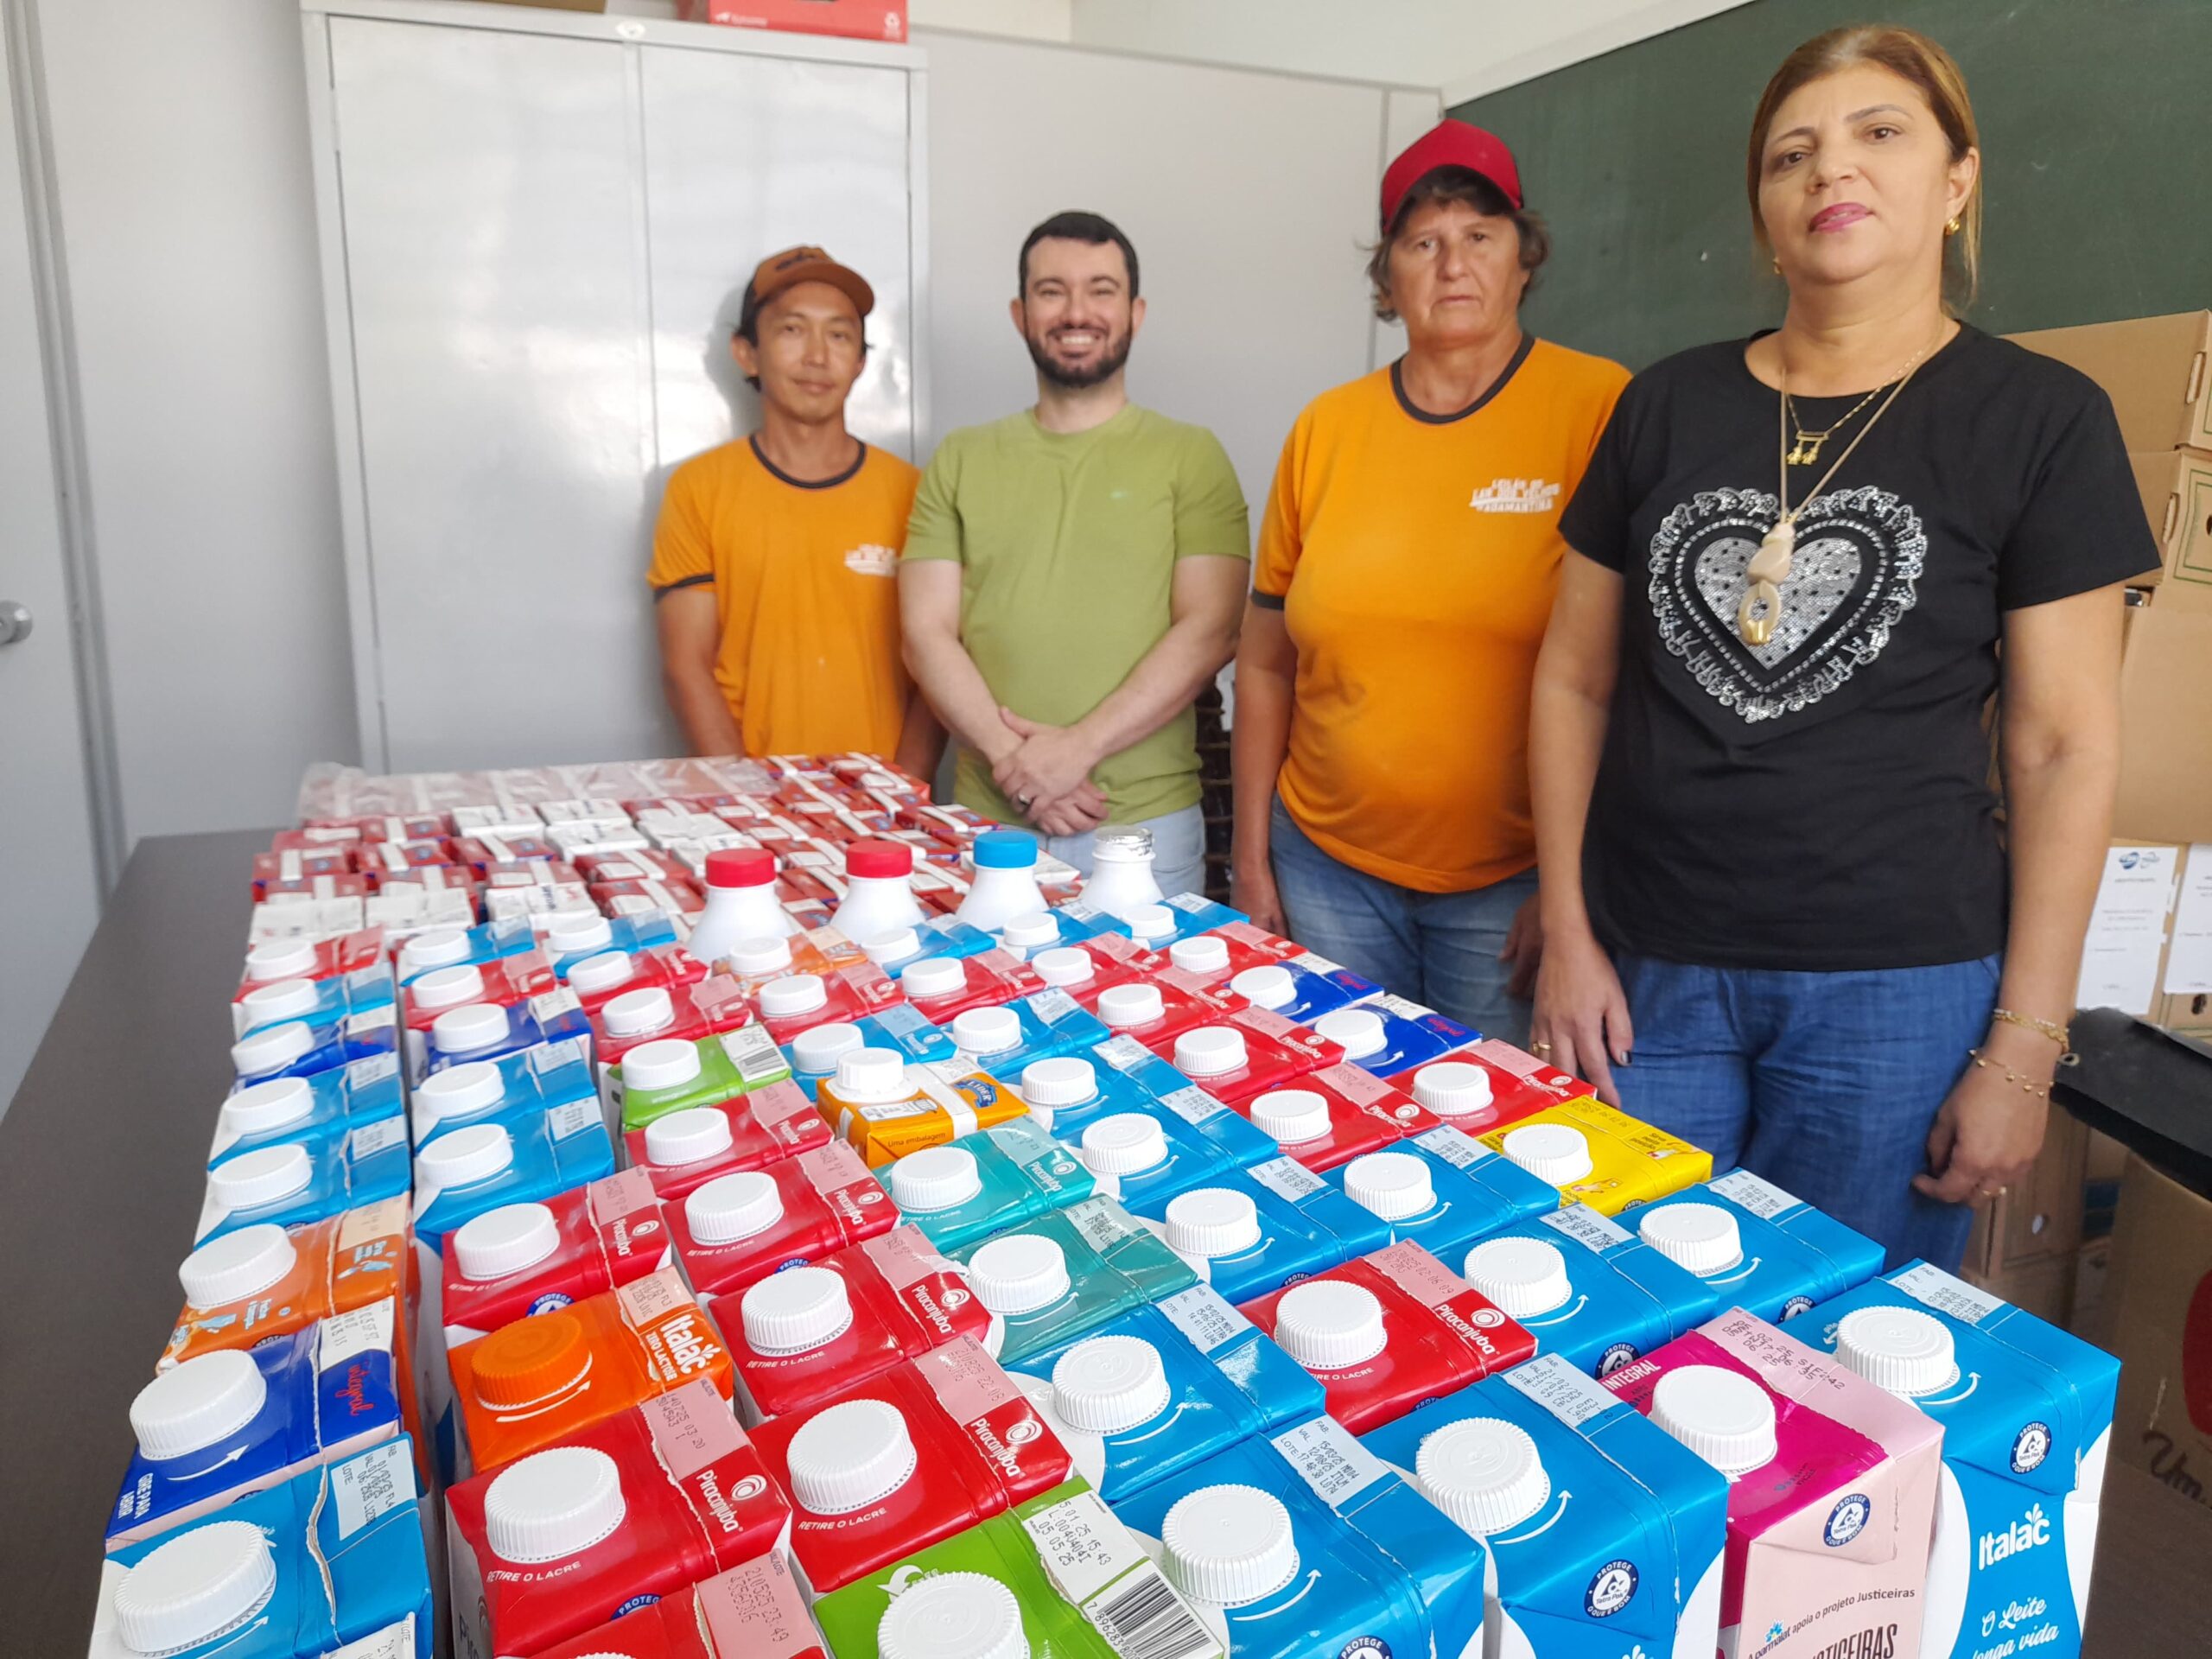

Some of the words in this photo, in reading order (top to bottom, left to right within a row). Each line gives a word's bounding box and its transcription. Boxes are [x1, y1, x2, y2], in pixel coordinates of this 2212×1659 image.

[912, 1284, 952, 1335] Piracanjuba
[1433, 1301, 1497, 1357] Piracanjuba
[658, 1312, 715, 1376] Italac
[1605, 1344, 1635, 1357] PROTEGE
[746, 1360, 777, 1370] RETIRE
[780, 1357, 788, 1367] O
[790, 1351, 824, 1365] LACRE
[1332, 1373, 1340, 1382] O
[1342, 1367, 1375, 1381] LACRE
[1601, 1359, 1662, 1391] INTEGRAL
[1298, 1428, 1312, 1443] VAL:
[1314, 1420, 1330, 1433] FAB:
[2019, 1422, 2047, 1438] PROTEGE
[970, 1417, 1022, 1478] Piracanjuba
[1280, 1436, 1300, 1458] LOTE:
[695, 1468, 741, 1534] Piracanjuba
[1834, 1495, 1866, 1512] PROTEGE
[798, 1520, 835, 1531] RETIRE
[836, 1519, 846, 1529] O
[848, 1508, 887, 1528] LACRE
[1037, 1519, 1075, 1567] 05.05.25
[1085, 1538, 1112, 1567] 15:43
[1979, 1516, 2050, 1571] Italac
[486, 1570, 520, 1583] RETIRE
[524, 1571, 533, 1581] O
[536, 1560, 582, 1580] LACRE
[1597, 1560, 1632, 1580] PROTEGE
[1613, 1595, 1631, 1612] BOM
[1792, 1612, 1814, 1635] apoia
[1814, 1610, 1821, 1620] o
[1822, 1595, 1856, 1618] projeto
[1857, 1588, 1916, 1603] Justiceiras
[1998, 1596, 2048, 1630] Leite
[1094, 1612, 1124, 1647] 896283
[2018, 1622, 2060, 1651] vida
[1342, 1637, 1382, 1659] PROTEGE
